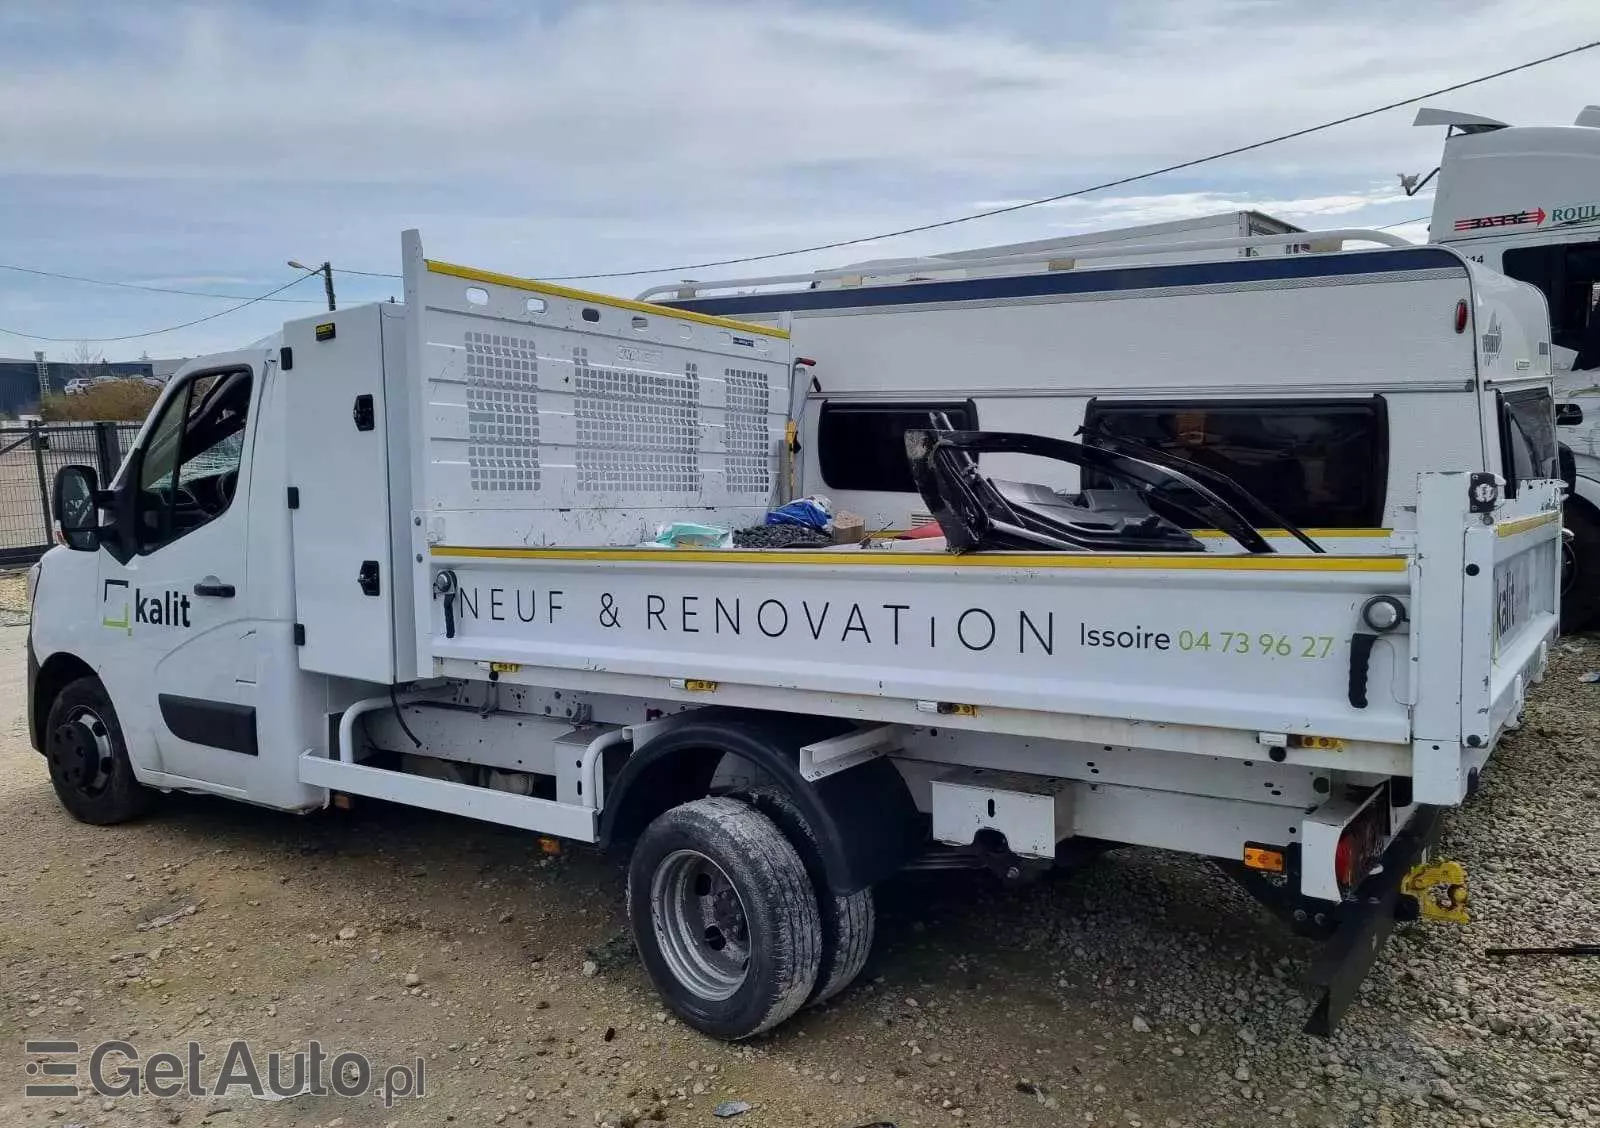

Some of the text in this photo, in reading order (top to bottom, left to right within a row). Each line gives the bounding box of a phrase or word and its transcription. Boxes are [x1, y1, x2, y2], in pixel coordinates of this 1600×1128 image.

[135, 588, 191, 627] kalit
[459, 587, 1334, 658] NEUF & RENOVATION Issoire 04 73 96 27
